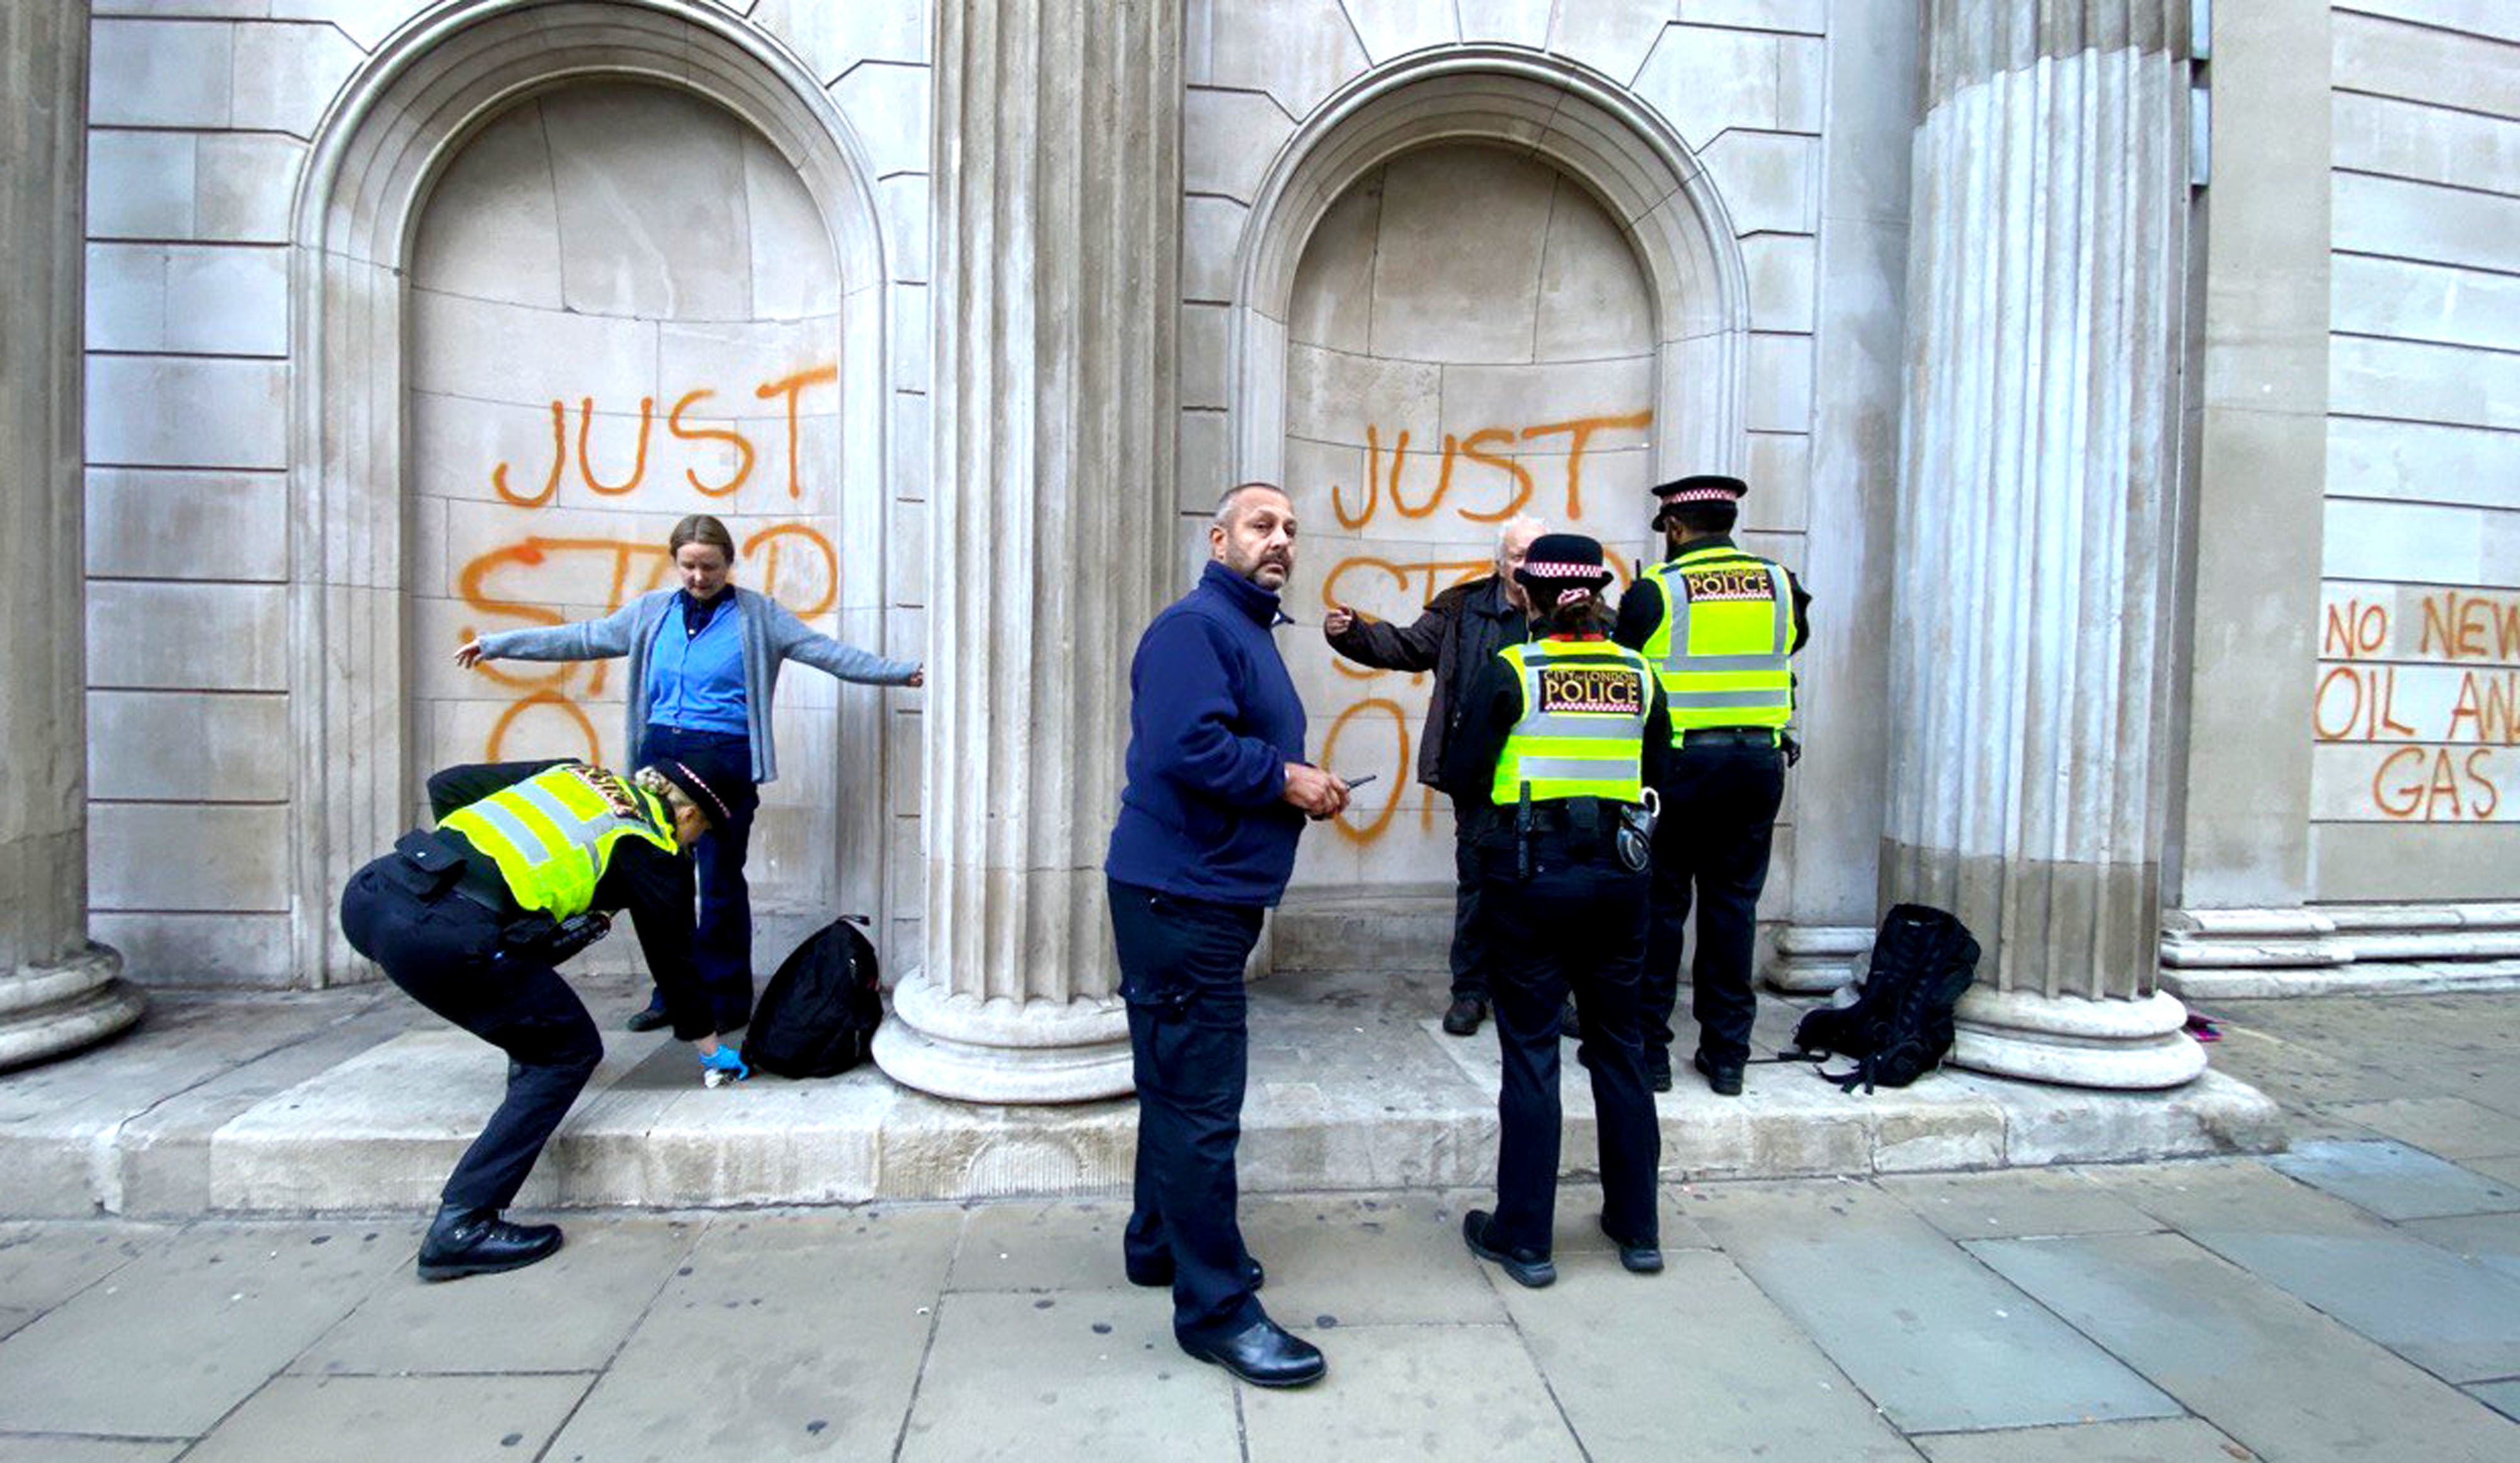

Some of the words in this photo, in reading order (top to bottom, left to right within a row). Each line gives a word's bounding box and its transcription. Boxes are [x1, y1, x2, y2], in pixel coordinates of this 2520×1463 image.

[493, 363, 837, 508] JUST
[1332, 409, 1652, 530] JUST
[458, 523, 837, 696] STP
[1690, 576, 1768, 595] POLICE
[2325, 600, 2387, 657] NO
[2420, 591, 2520, 659] NEW
[1544, 671, 1574, 681] CITY
[1584, 671, 1638, 683] LONDON
[1545, 679, 1639, 703] POLICE
[2313, 667, 2415, 741] OIL
[2447, 670, 2520, 748] AN
[2372, 746, 2497, 821] GAS
